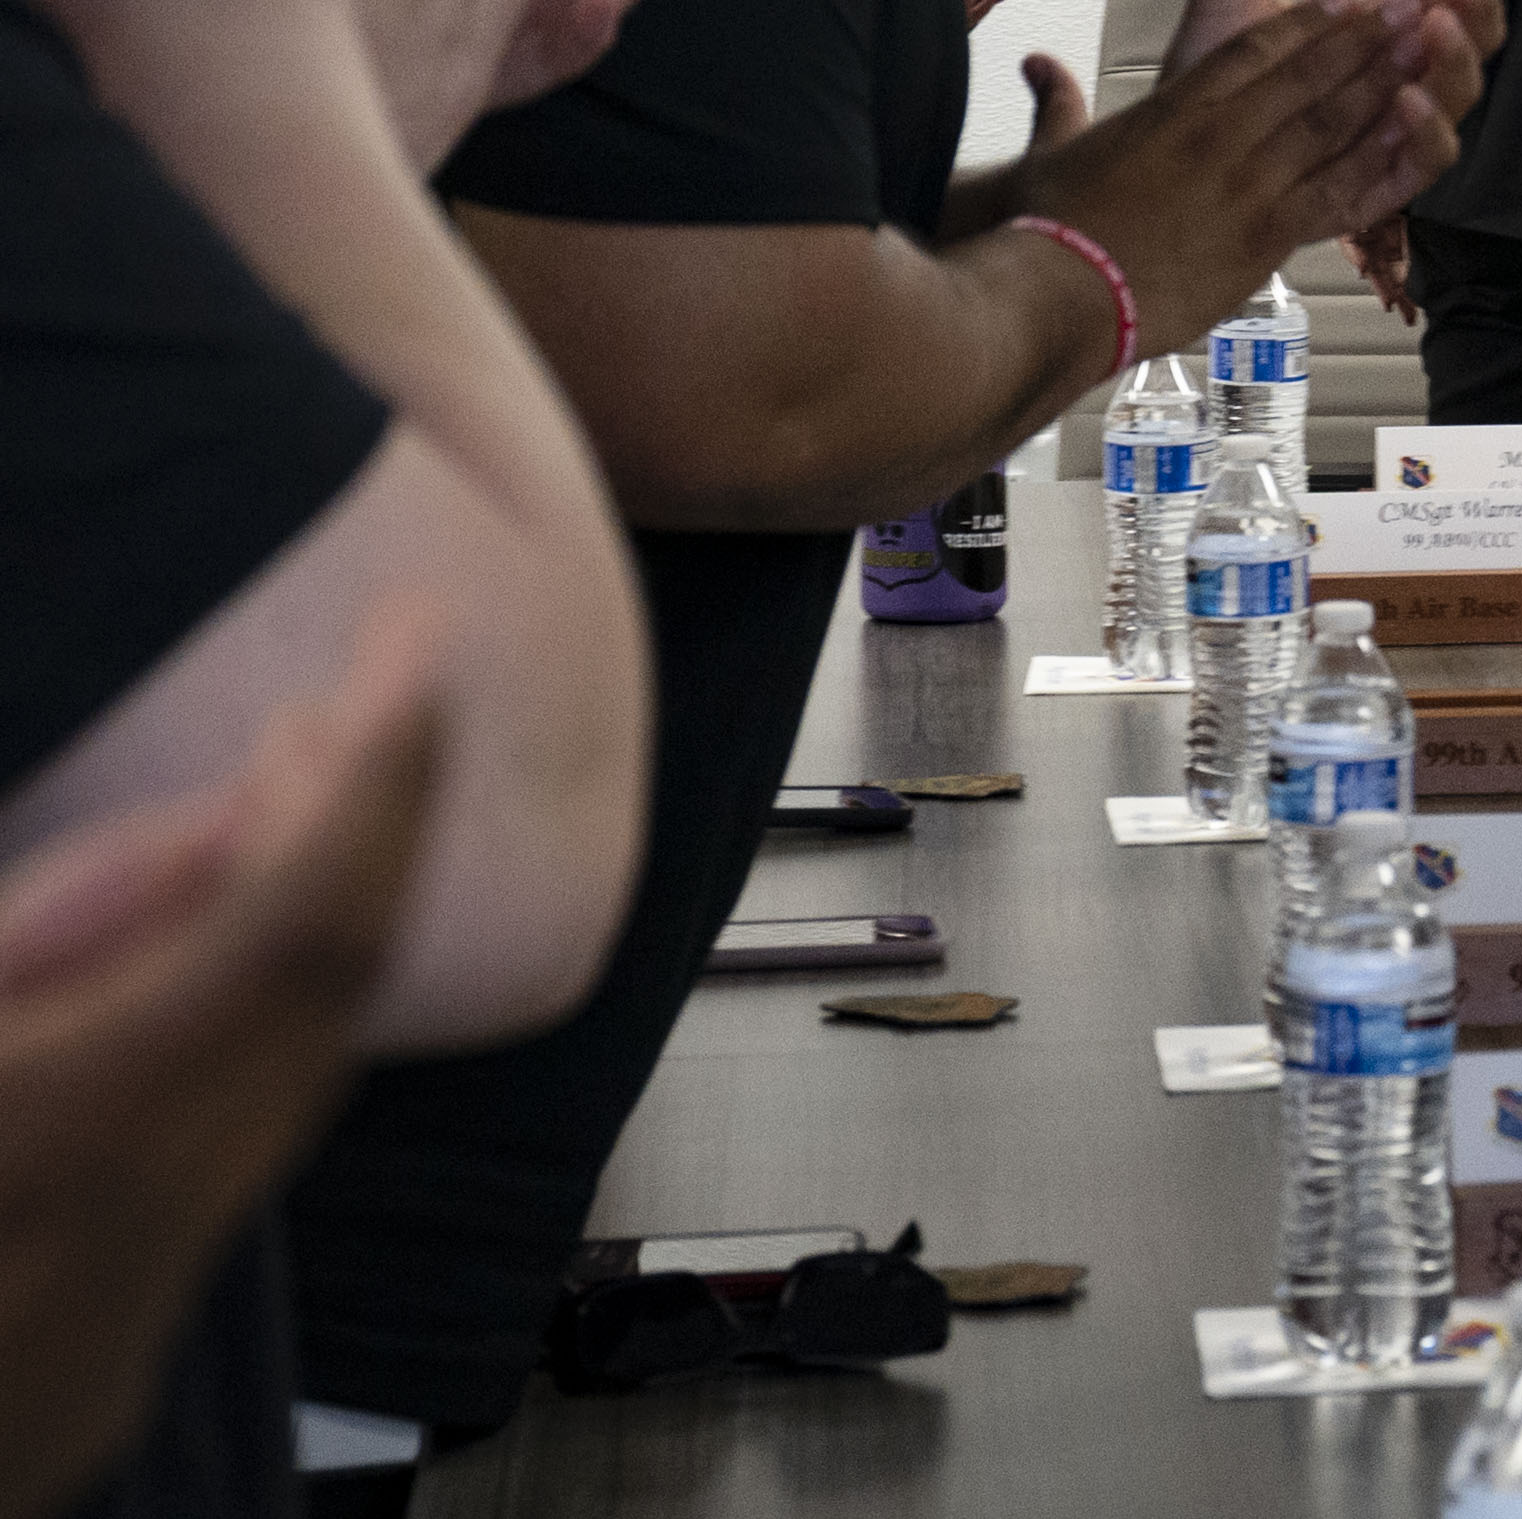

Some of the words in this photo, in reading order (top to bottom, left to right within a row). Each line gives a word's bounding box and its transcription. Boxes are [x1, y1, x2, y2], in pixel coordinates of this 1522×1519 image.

[1410, 596, 1449, 618] Air
[1459, 595, 1520, 618] Base
[1422, 739, 1489, 768] 99th
